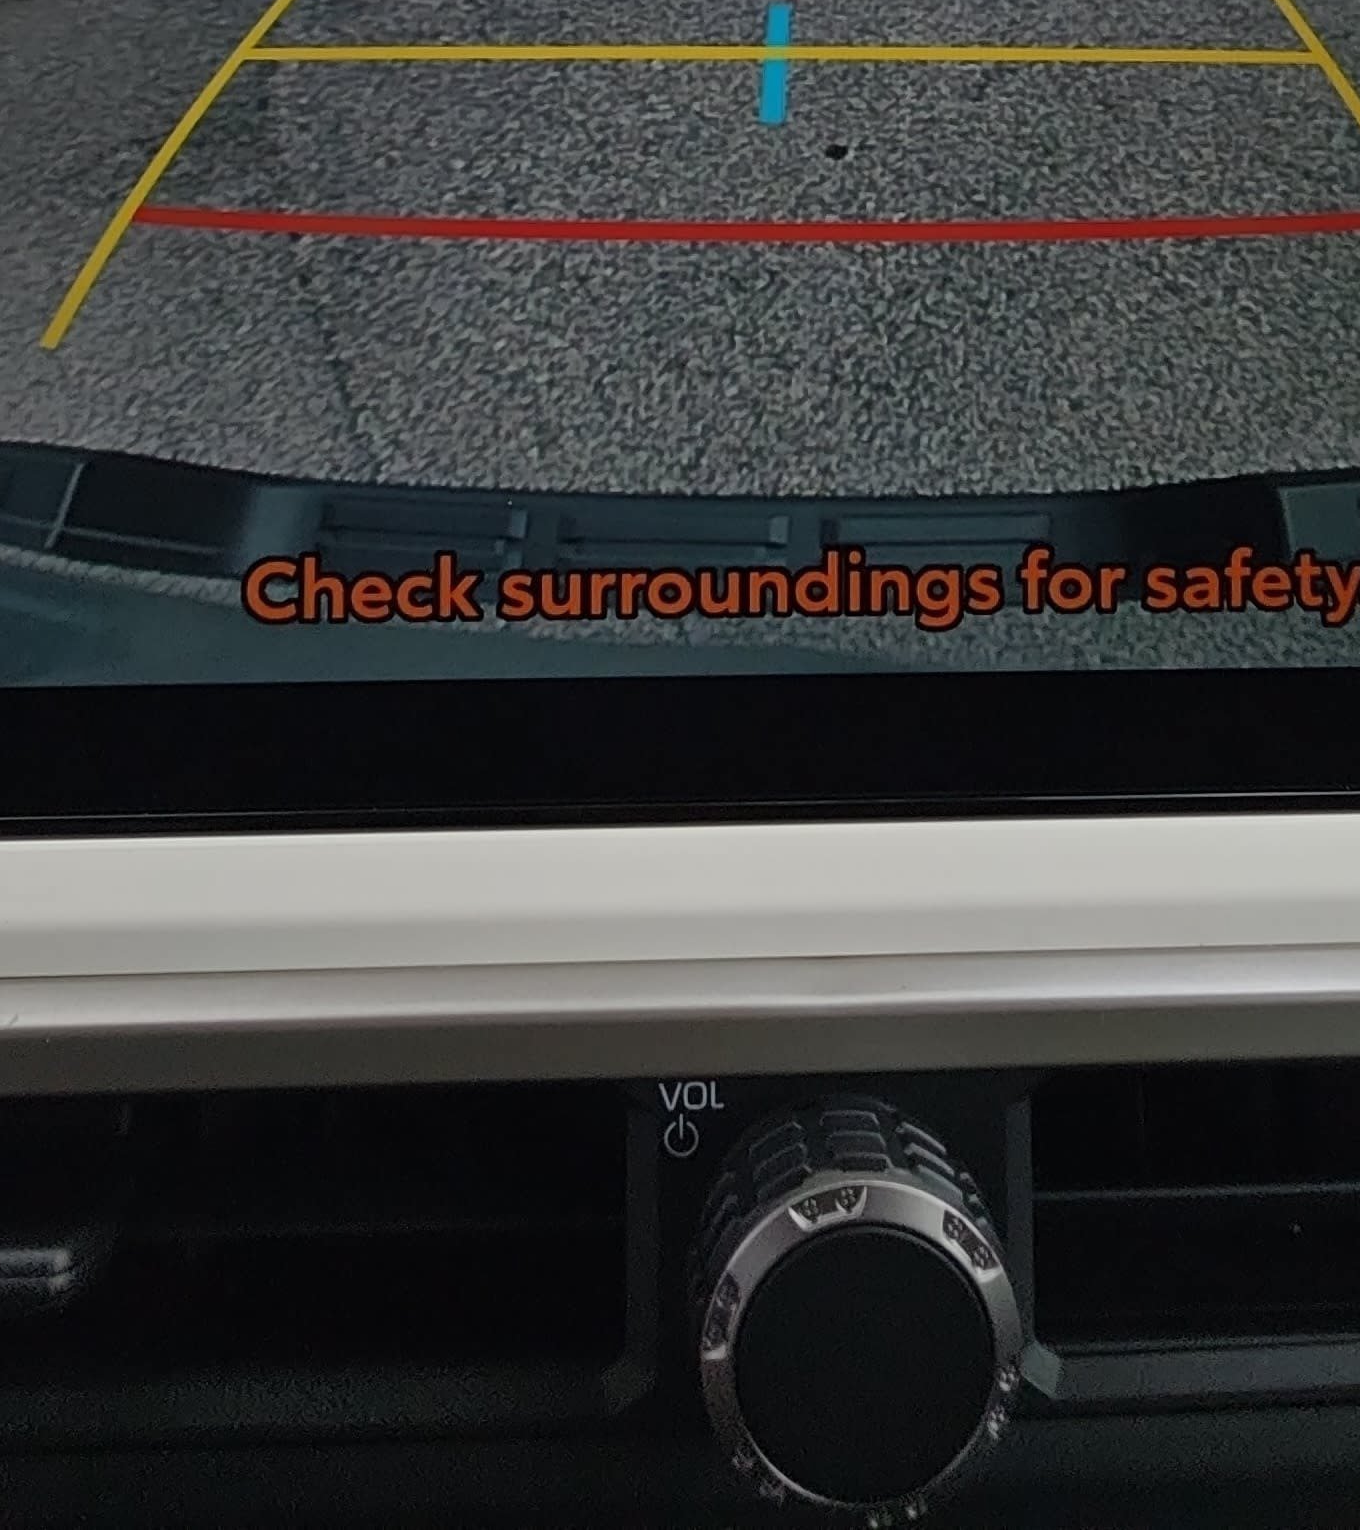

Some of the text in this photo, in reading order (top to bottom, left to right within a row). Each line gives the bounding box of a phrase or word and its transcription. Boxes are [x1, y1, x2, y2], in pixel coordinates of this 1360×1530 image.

[245, 556, 476, 621] Check
[502, 550, 1000, 628] surroundings
[1021, 547, 1126, 610] for
[658, 1080, 725, 1111] VOL
